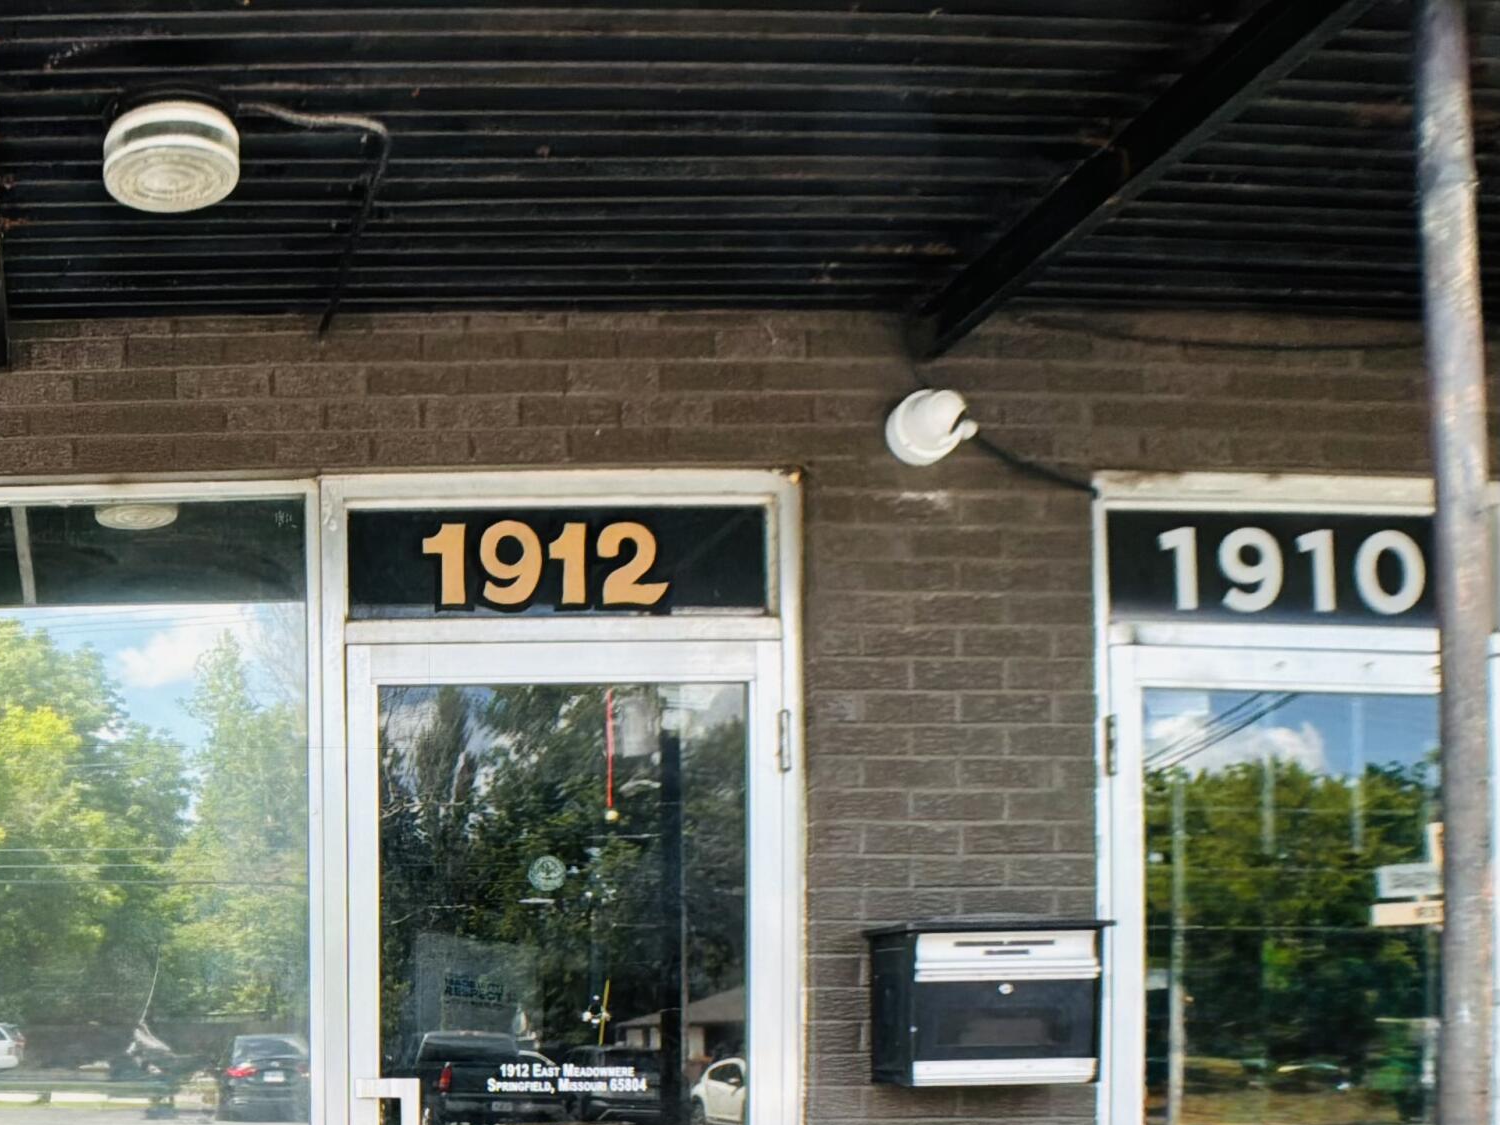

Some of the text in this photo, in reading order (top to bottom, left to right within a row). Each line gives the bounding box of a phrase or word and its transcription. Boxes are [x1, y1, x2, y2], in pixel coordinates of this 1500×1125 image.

[422, 519, 671, 605] 1912
[1157, 526, 1426, 615] 1910
[500, 1063, 530, 1077] 1912
[609, 1078, 647, 1092] 65804
